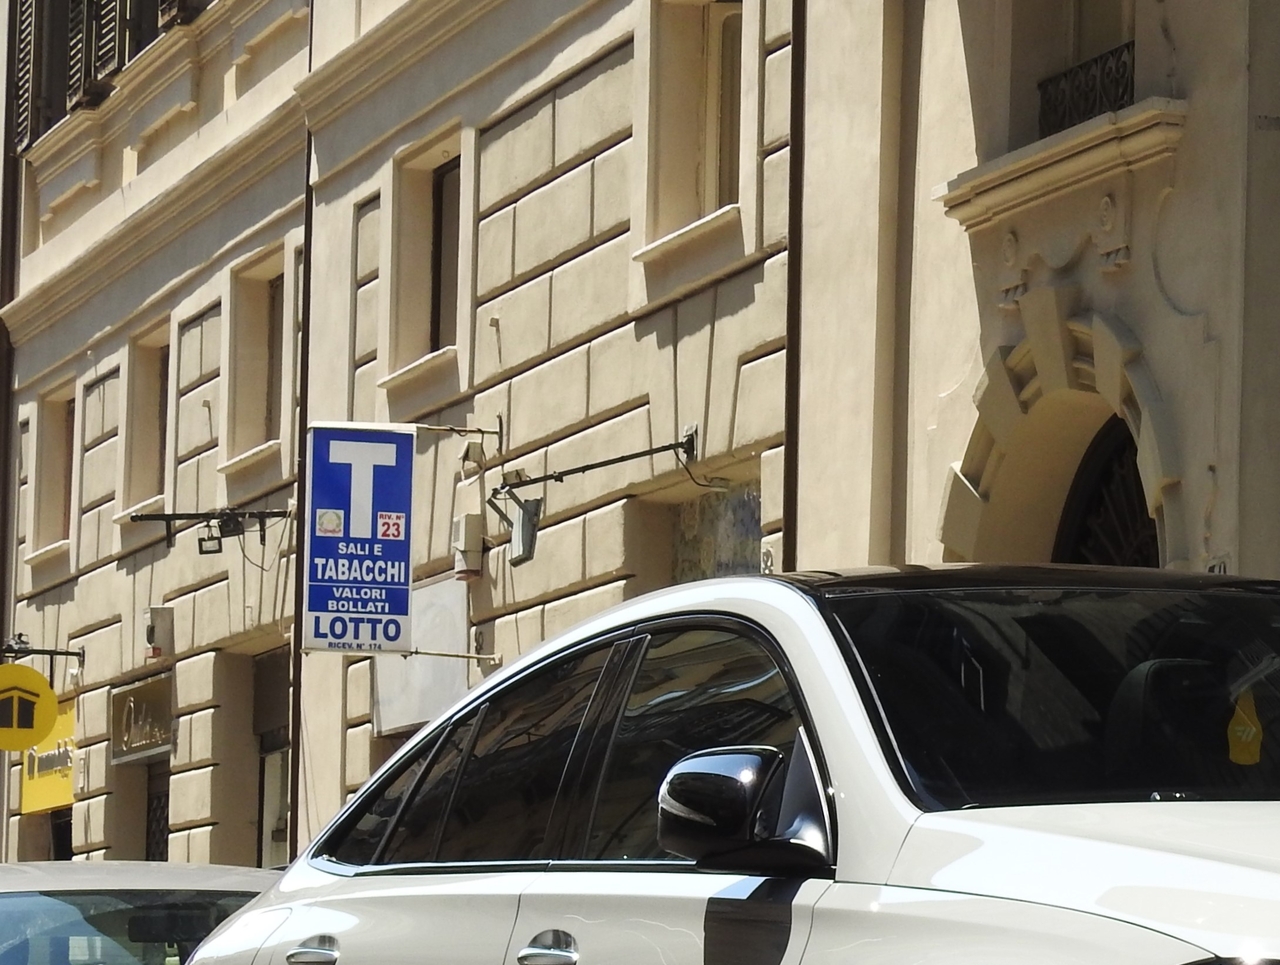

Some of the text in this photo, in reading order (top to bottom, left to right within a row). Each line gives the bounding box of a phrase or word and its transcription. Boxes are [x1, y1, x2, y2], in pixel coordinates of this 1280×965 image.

[329, 440, 397, 538] T
[379, 513, 394, 521] RIV.
[381, 521, 402, 539] 23
[338, 541, 383, 556] SALI E
[314, 557, 406, 583] TABACCHI
[333, 587, 386, 599] VALORI
[327, 600, 389, 613] BOLLATI
[313, 616, 401, 641] LOTTO
[328, 641, 355, 650] RICEV.
